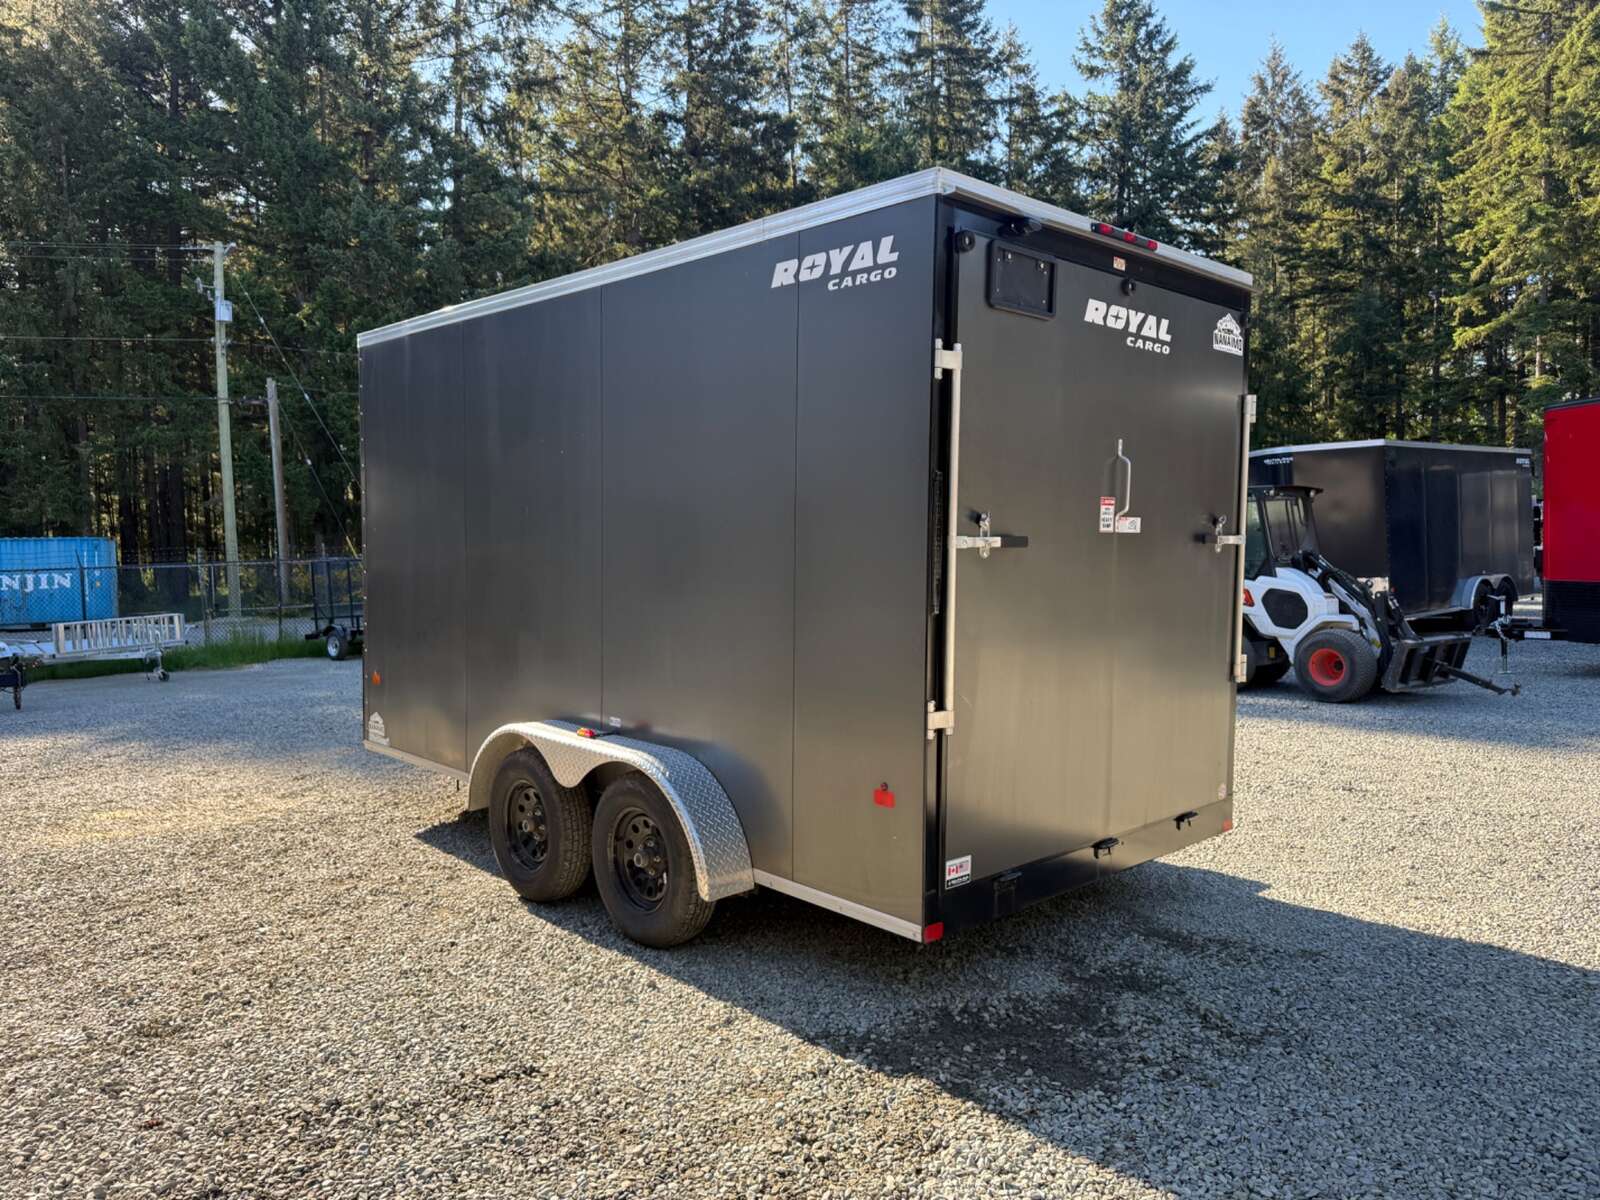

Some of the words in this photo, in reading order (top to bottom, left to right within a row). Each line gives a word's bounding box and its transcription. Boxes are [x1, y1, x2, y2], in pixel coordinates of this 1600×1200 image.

[771, 235, 899, 288] ROYAL
[827, 267, 897, 291] CARGO
[1084, 298, 1172, 343] ROYAL
[1126, 336, 1170, 355] CARGO
[1214, 333, 1242, 351] NANAIMO
[0, 573, 72, 592] NJIN
